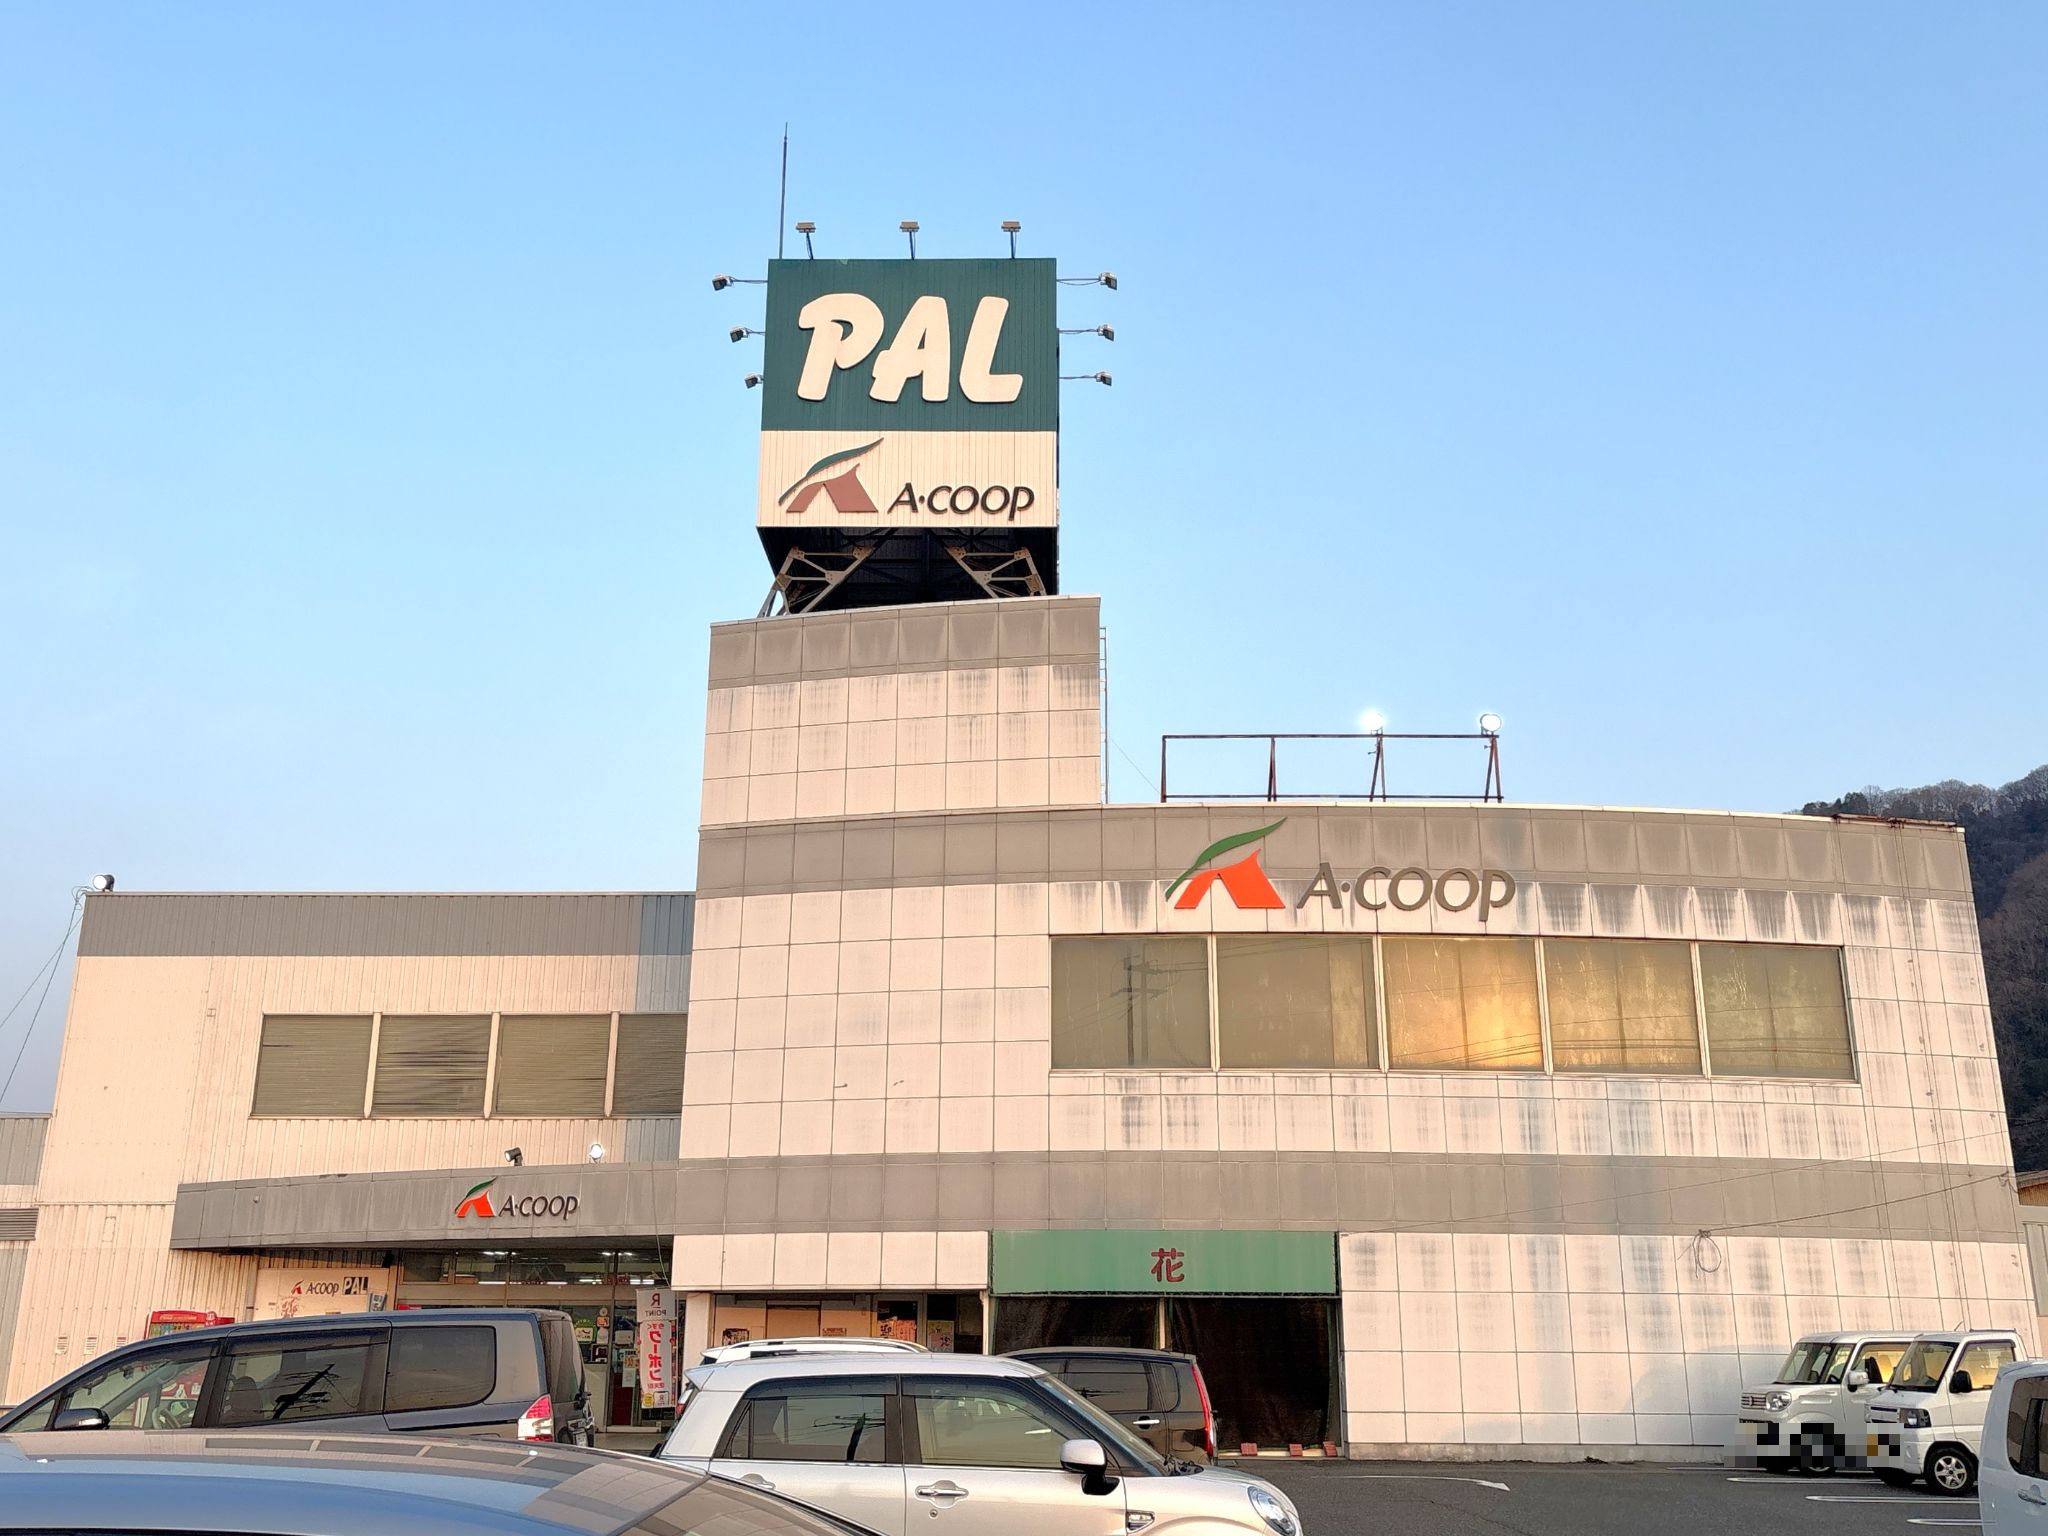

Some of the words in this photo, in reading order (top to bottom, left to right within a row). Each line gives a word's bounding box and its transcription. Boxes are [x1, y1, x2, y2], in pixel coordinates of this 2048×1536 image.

[797, 293, 1023, 403] PAL
[1151, 1248, 1185, 1283] 花
[342, 1276, 368, 1295] PAL
